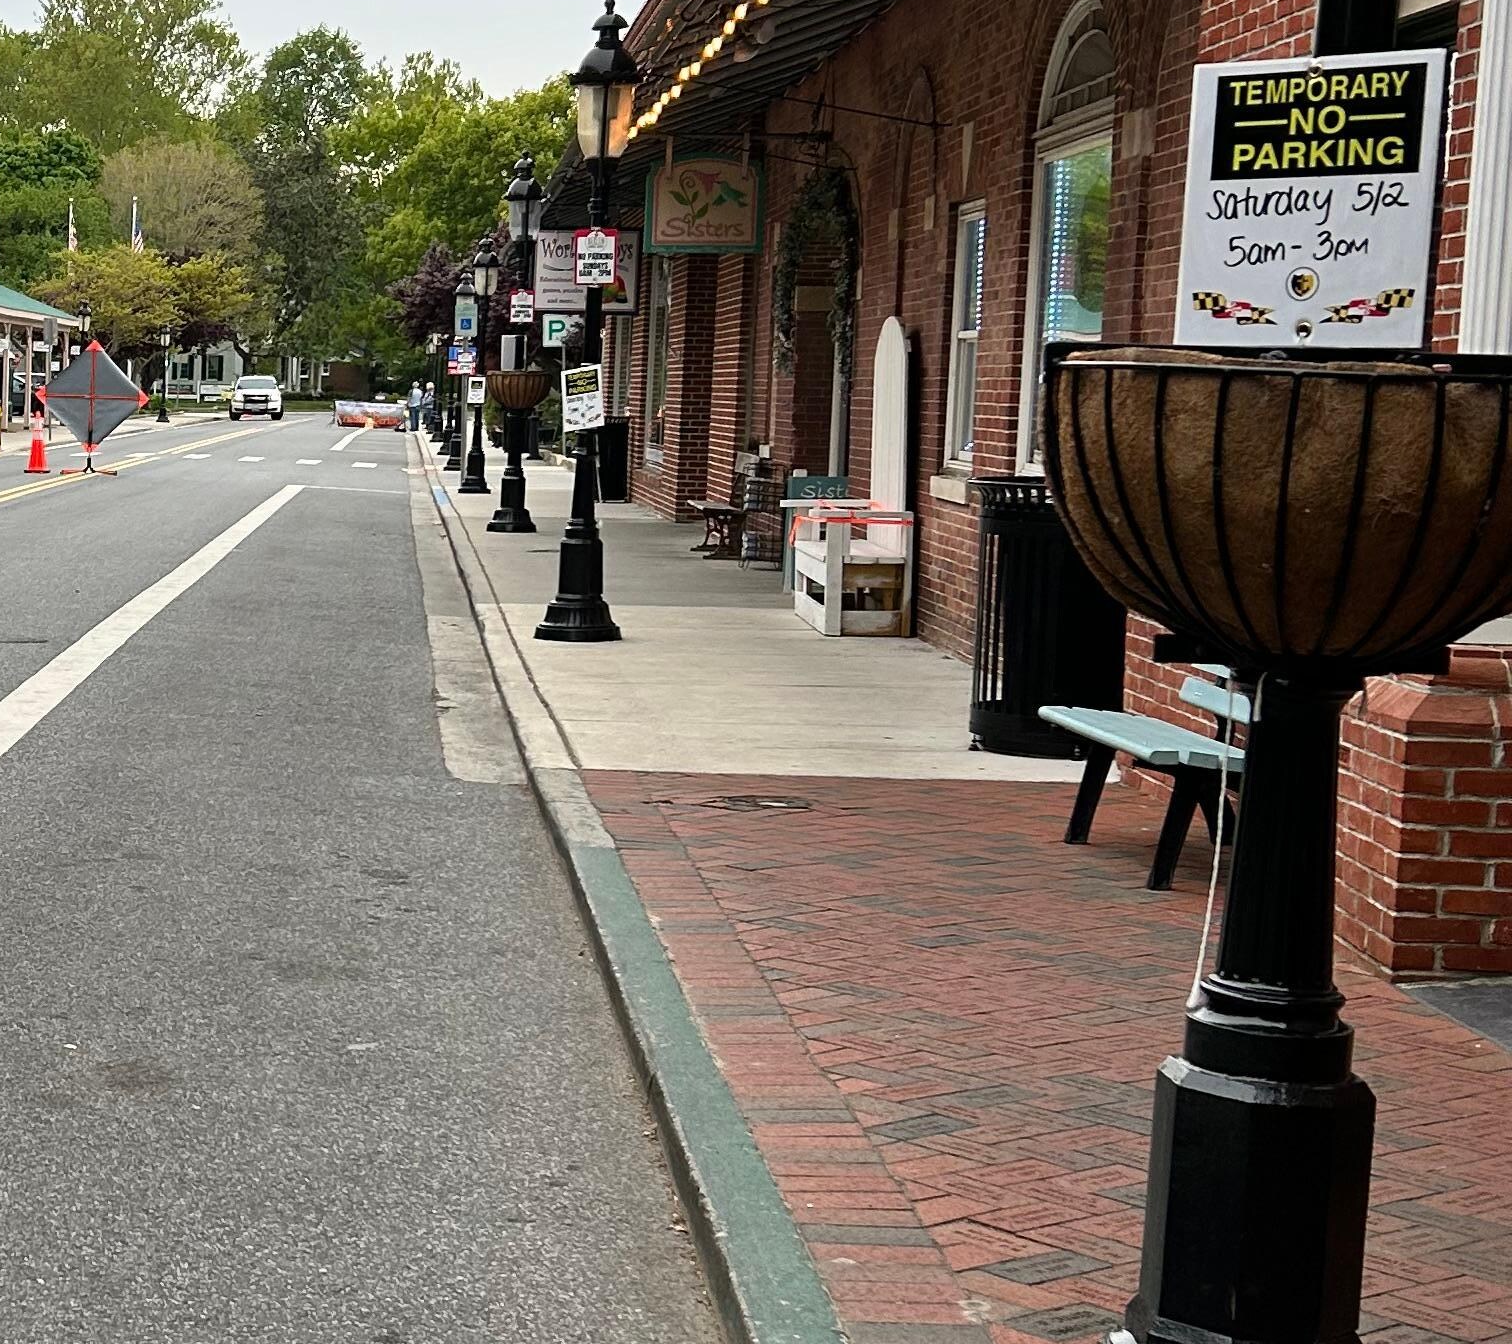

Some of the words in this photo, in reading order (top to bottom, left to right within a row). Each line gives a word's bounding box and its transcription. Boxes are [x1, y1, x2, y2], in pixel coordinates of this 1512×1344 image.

[1230, 70, 1410, 106] TEMPORARY
[1289, 105, 1346, 136] NO
[1231, 136, 1405, 172] PARKING
[1206, 186, 1333, 226] Saturday
[1351, 180, 1410, 216] 5/2
[661, 215, 745, 238] Sisters
[549, 320, 565, 340] P
